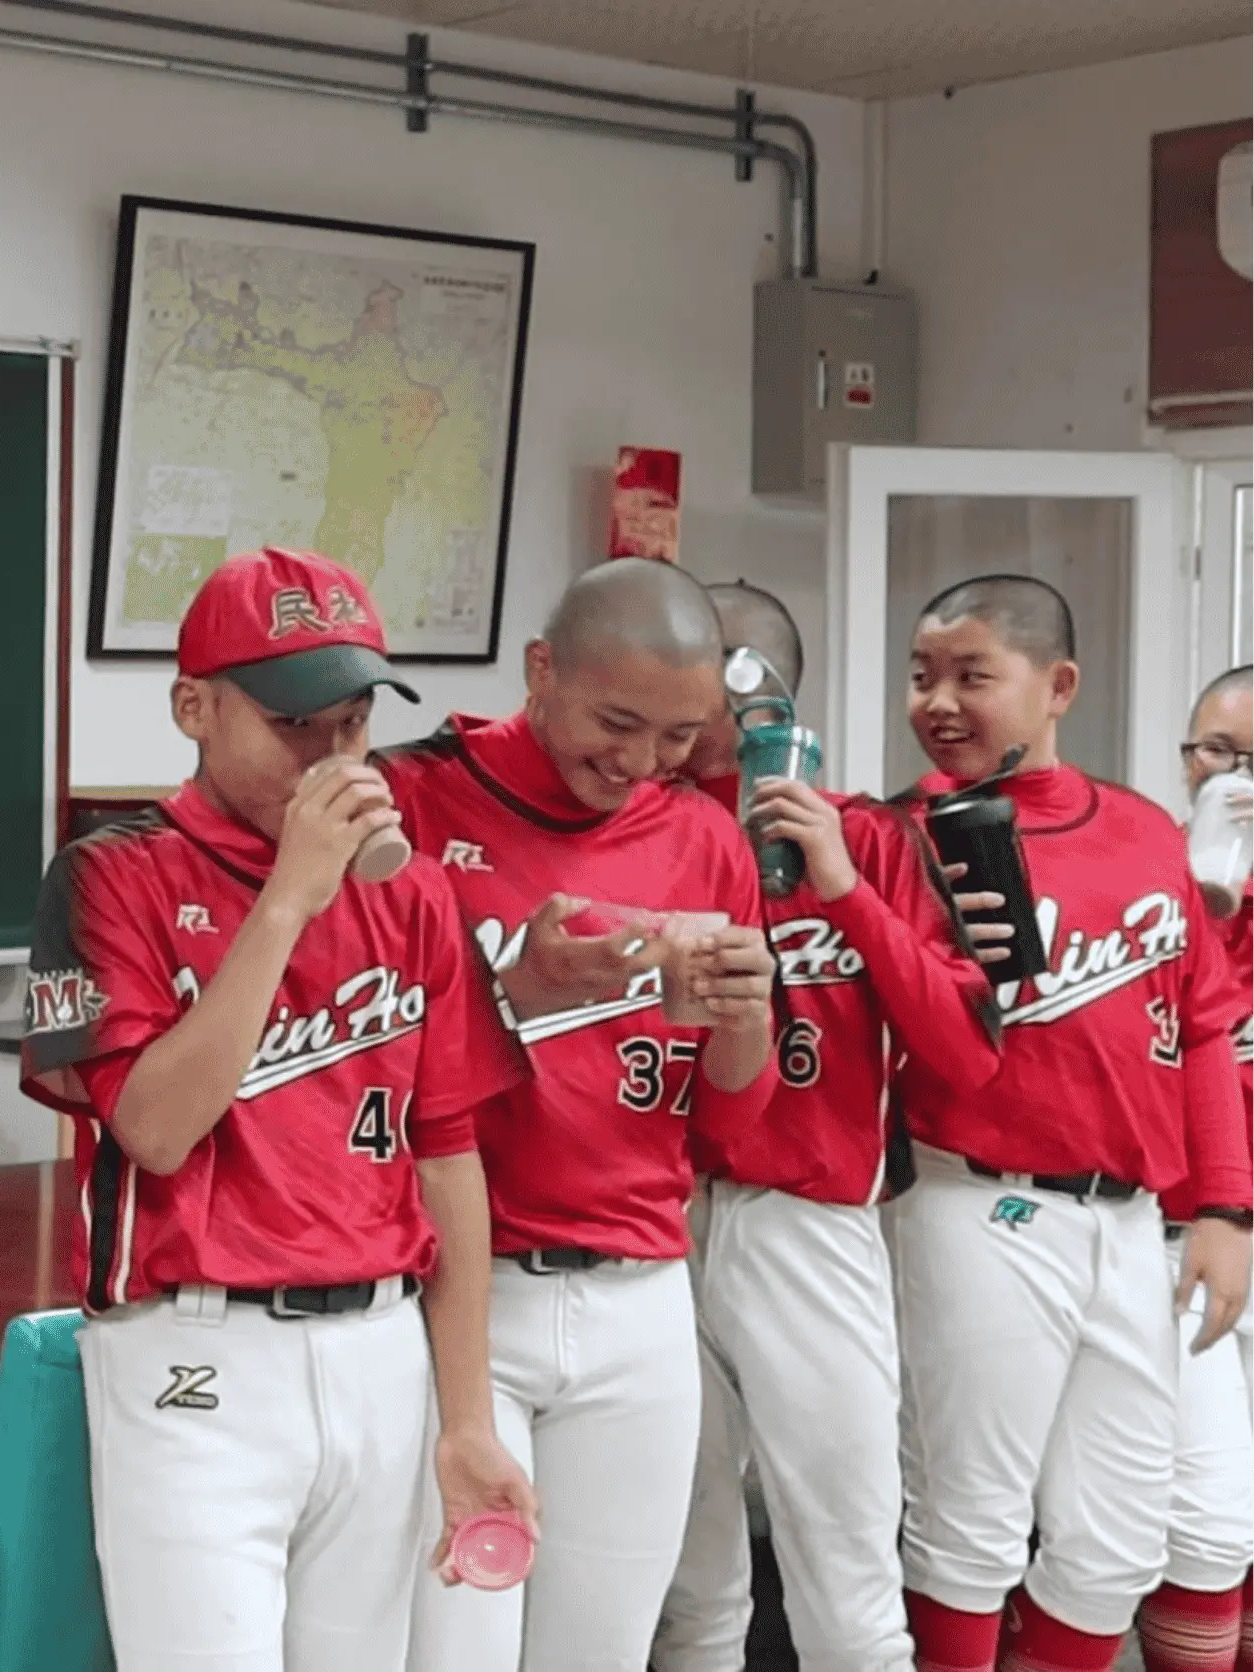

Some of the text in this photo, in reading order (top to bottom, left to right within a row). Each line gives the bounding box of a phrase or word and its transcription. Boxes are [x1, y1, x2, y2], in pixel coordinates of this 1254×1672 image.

[769, 918, 865, 977] Ho
[1123, 892, 1187, 956] H
[335, 966, 424, 1039] Ho
[617, 1036, 698, 1117] 37
[348, 1086, 413, 1163] 4
